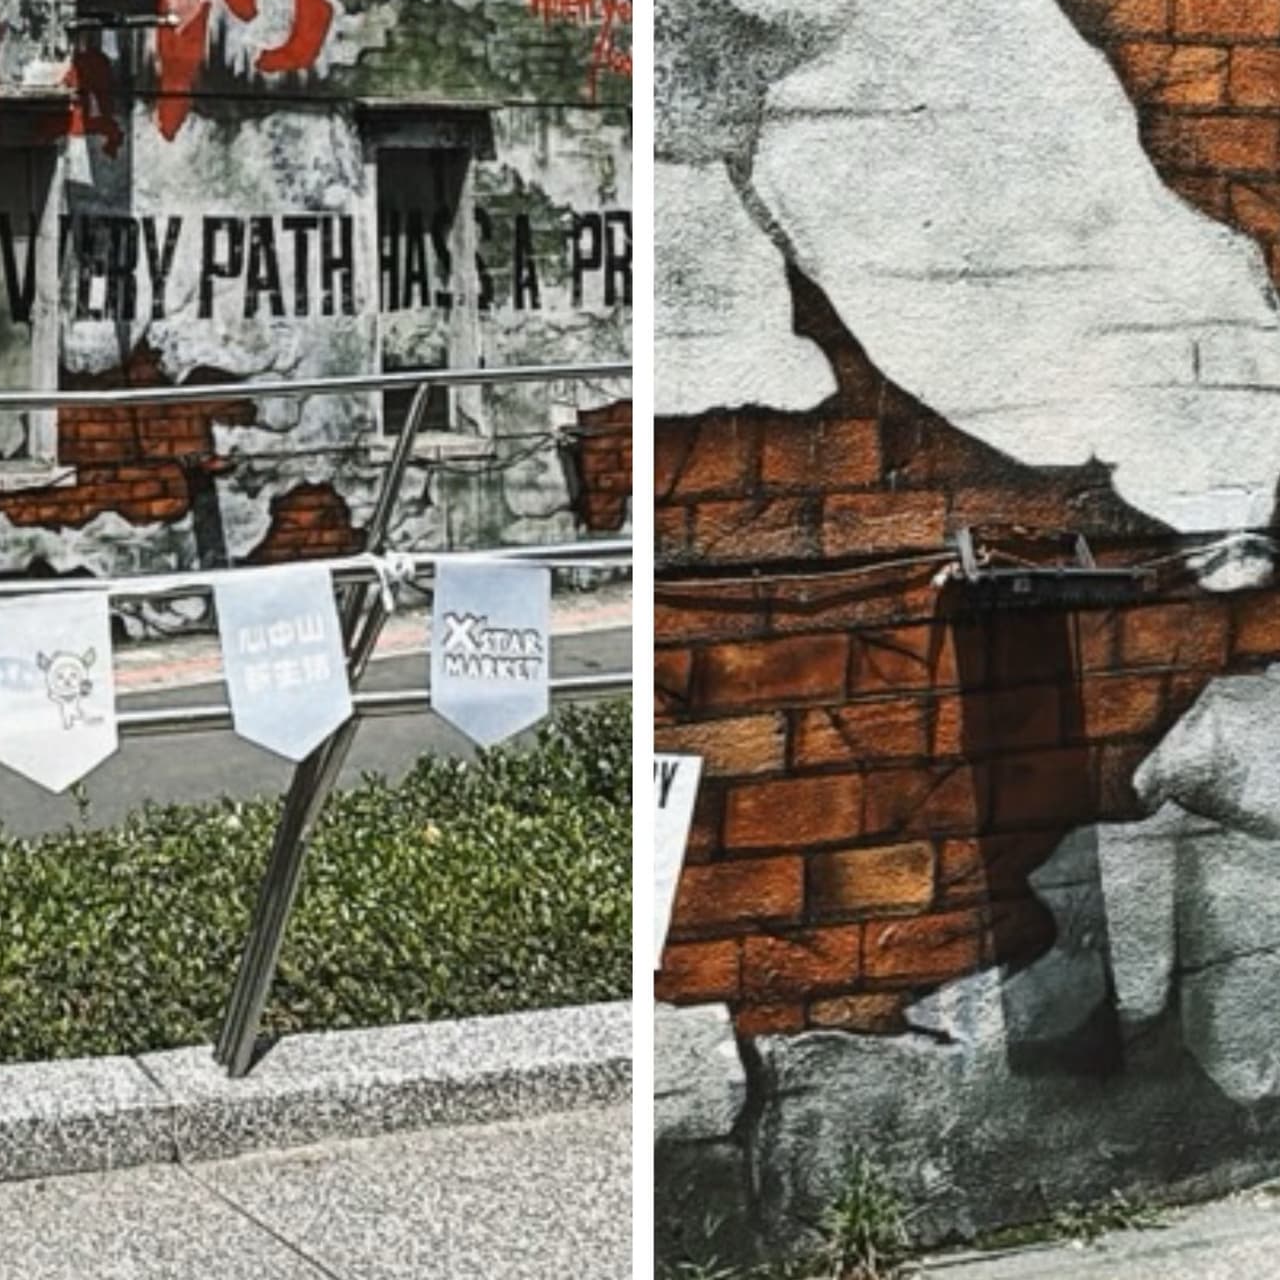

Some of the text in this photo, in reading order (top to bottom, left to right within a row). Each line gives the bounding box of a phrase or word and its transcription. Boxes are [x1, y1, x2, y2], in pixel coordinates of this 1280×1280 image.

[197, 215, 356, 320] PATH
[378, 209, 493, 313] HAS
[513, 213, 540, 311] A
[443, 653, 543, 681] MARKET
